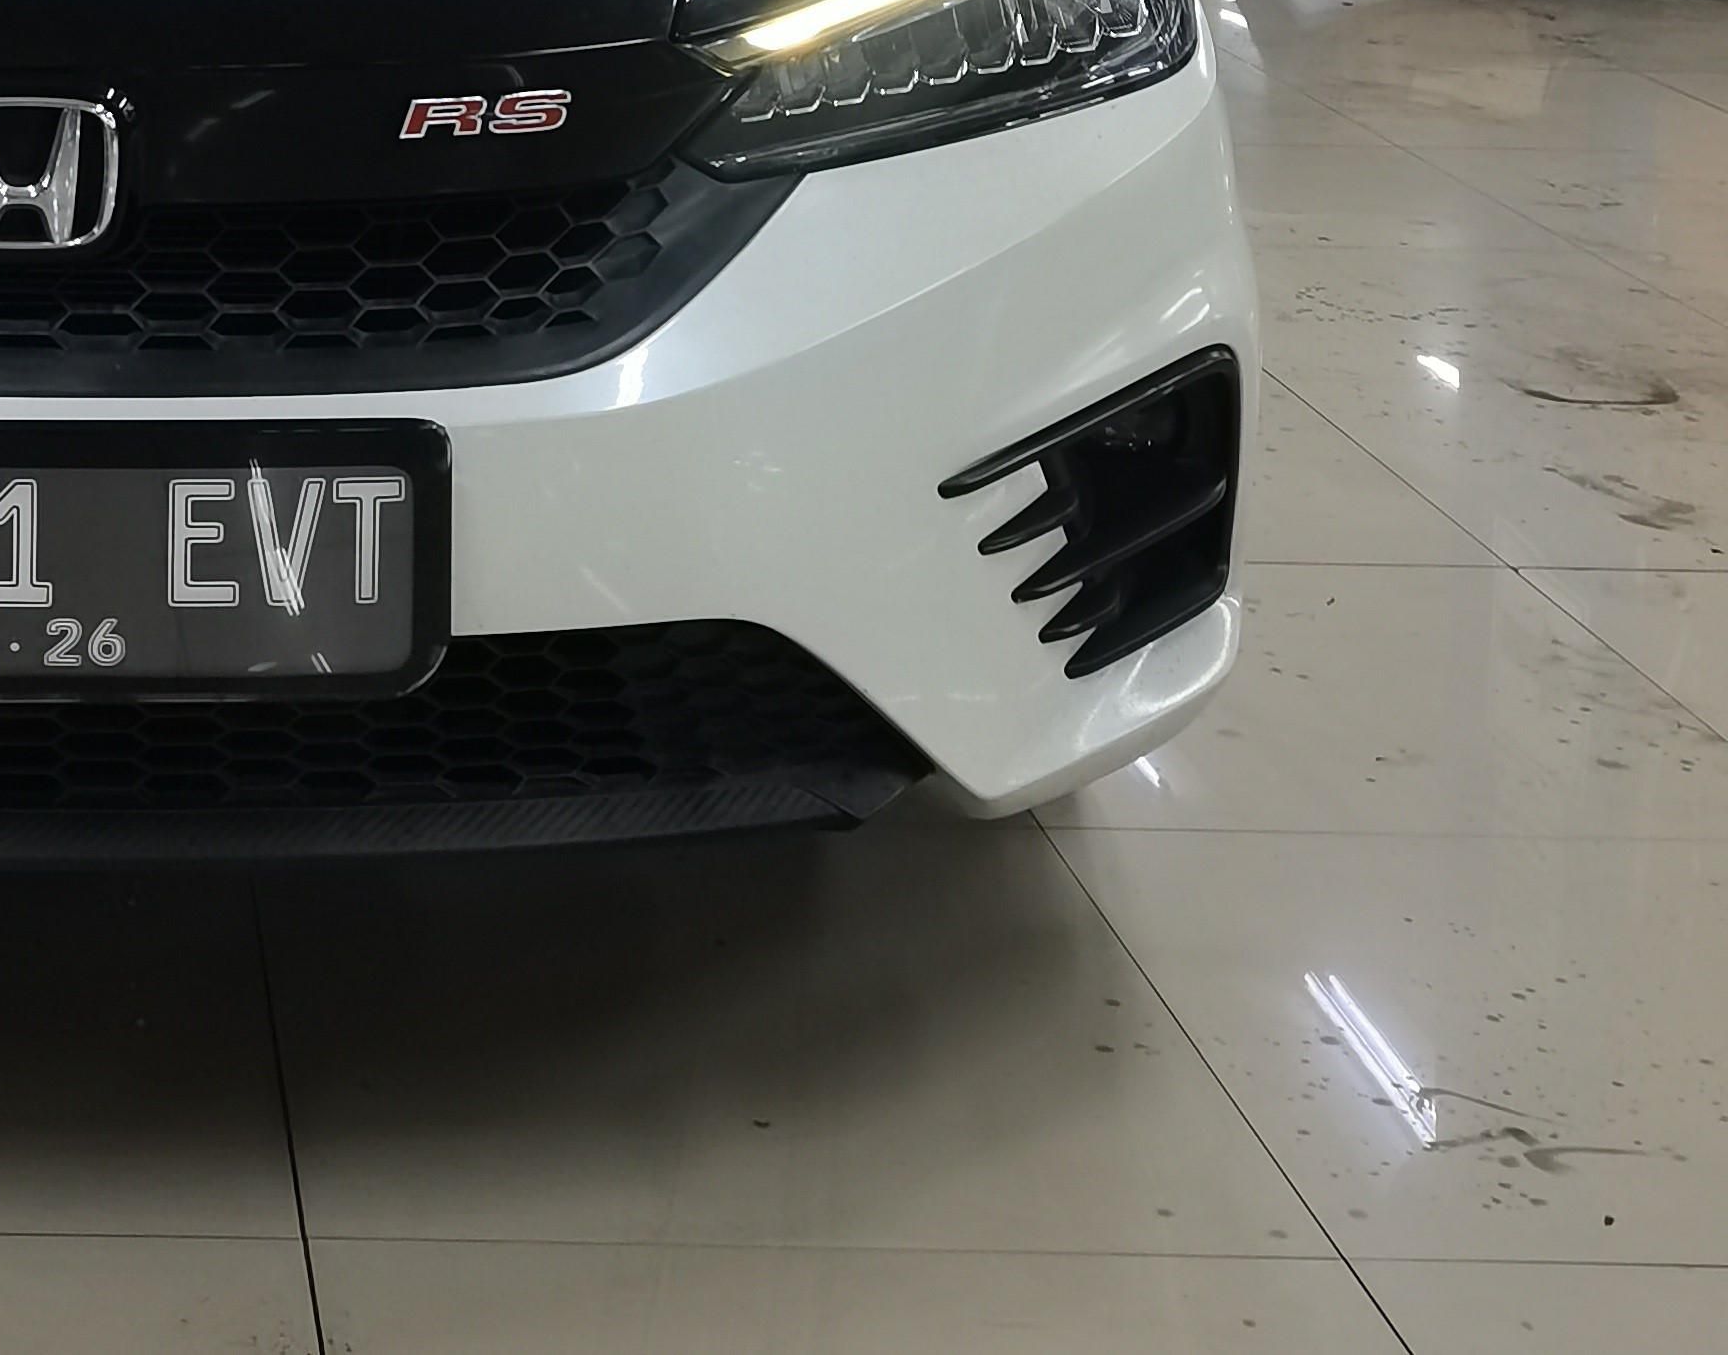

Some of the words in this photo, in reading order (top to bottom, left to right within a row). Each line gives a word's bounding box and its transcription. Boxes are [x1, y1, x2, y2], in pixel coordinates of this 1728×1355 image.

[398, 88, 572, 140] RS
[167, 476, 407, 608] EVT
[41, 616, 126, 668] 26
